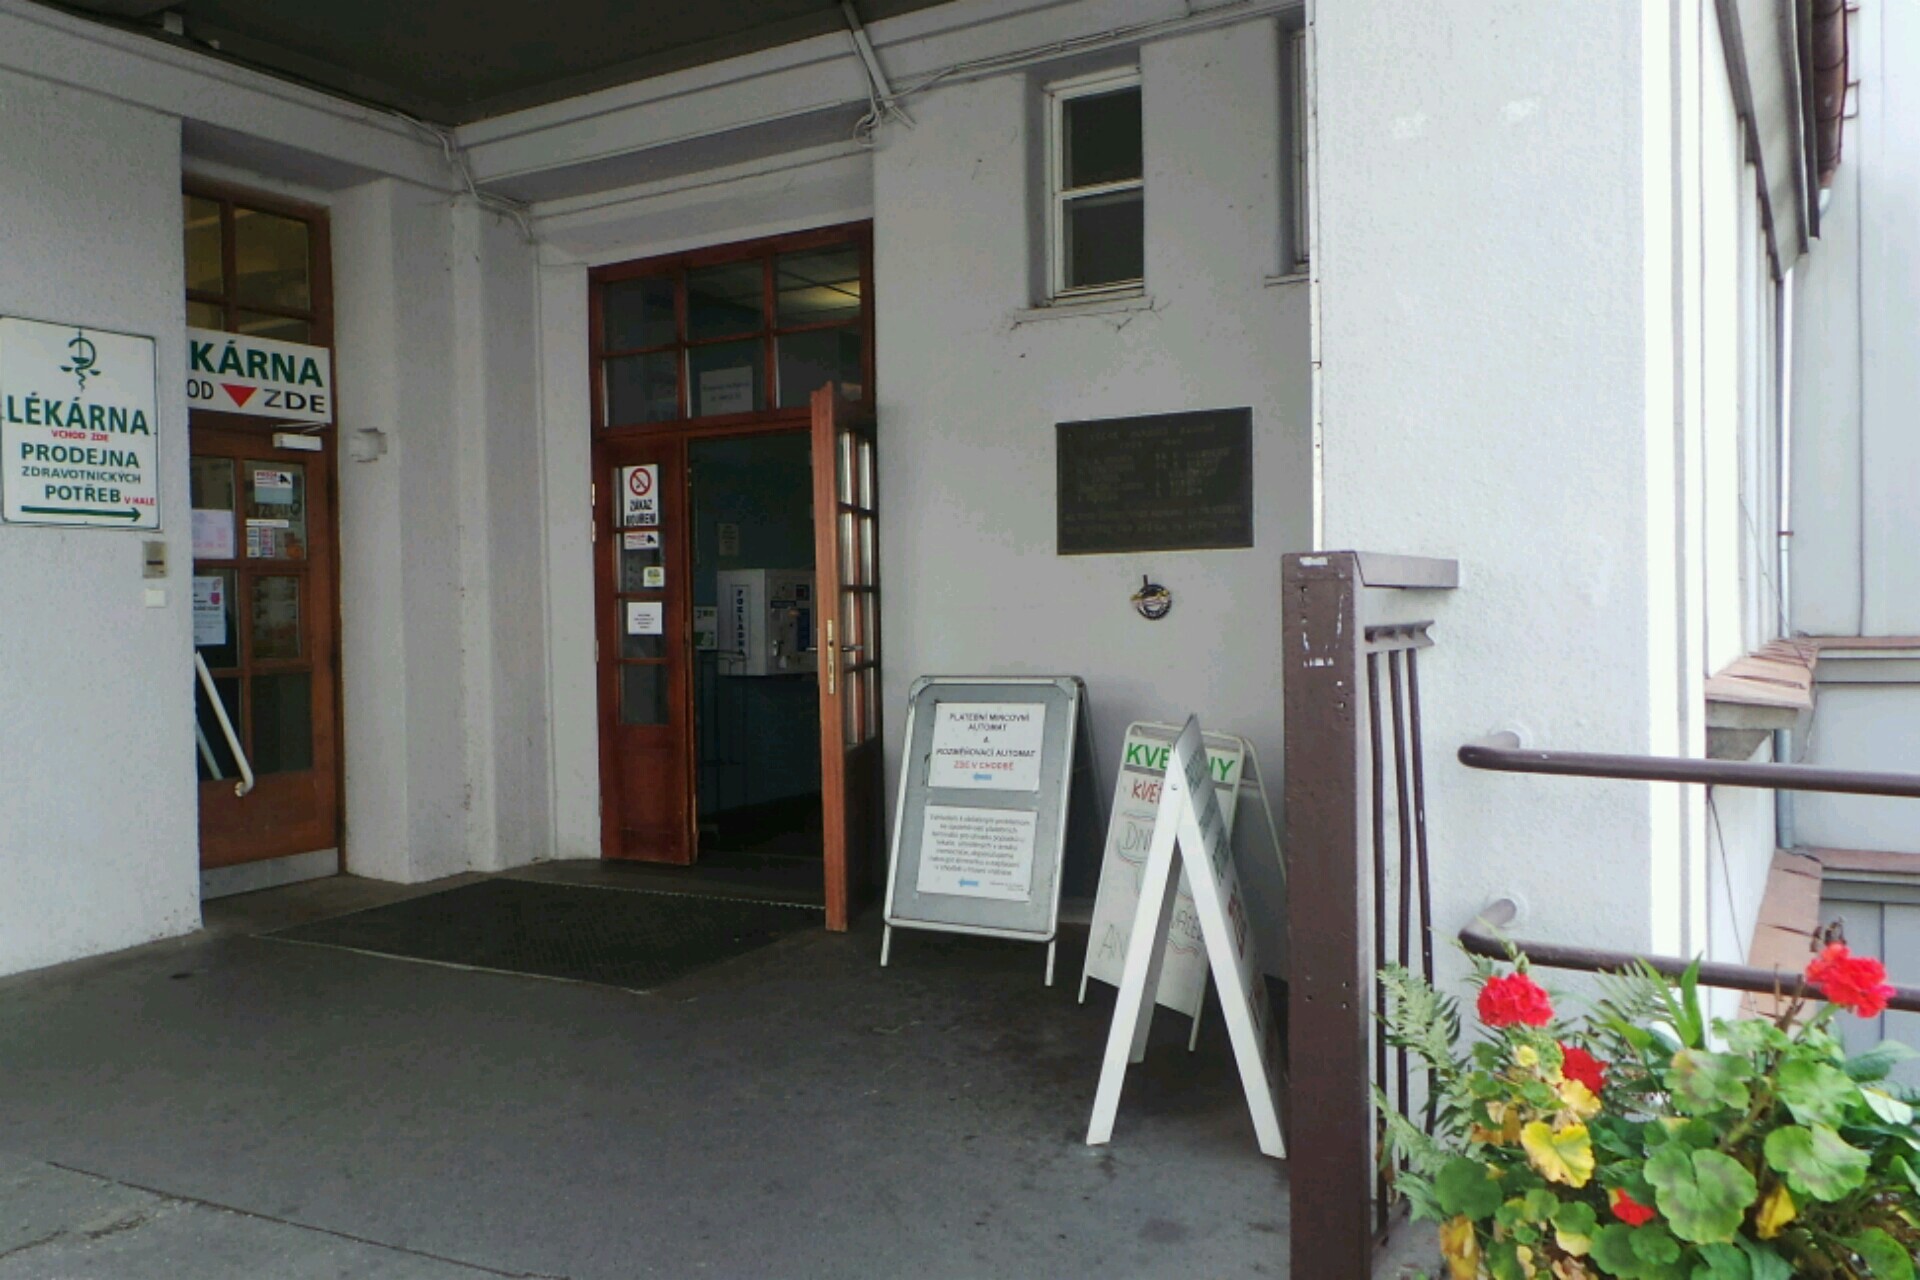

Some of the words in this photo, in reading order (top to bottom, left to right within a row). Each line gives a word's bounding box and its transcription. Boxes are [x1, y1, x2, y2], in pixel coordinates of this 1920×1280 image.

[190, 340, 323, 387] KÁRNA
[187, 379, 214, 400] OD
[263, 388, 325, 413] ZDE
[7, 392, 149, 435] LÉKÁRNA
[51, 430, 86, 440] VCHOD
[91, 432, 109, 442] ZDE
[21, 442, 140, 468] PRODEJNA
[21, 466, 141, 484] ZDRAVOTNICKÝCH
[45, 484, 121, 503] POTŘEB
[968, 723, 1007, 731] AUTOMAT
[995, 749, 1036, 758] AUTOMAT
